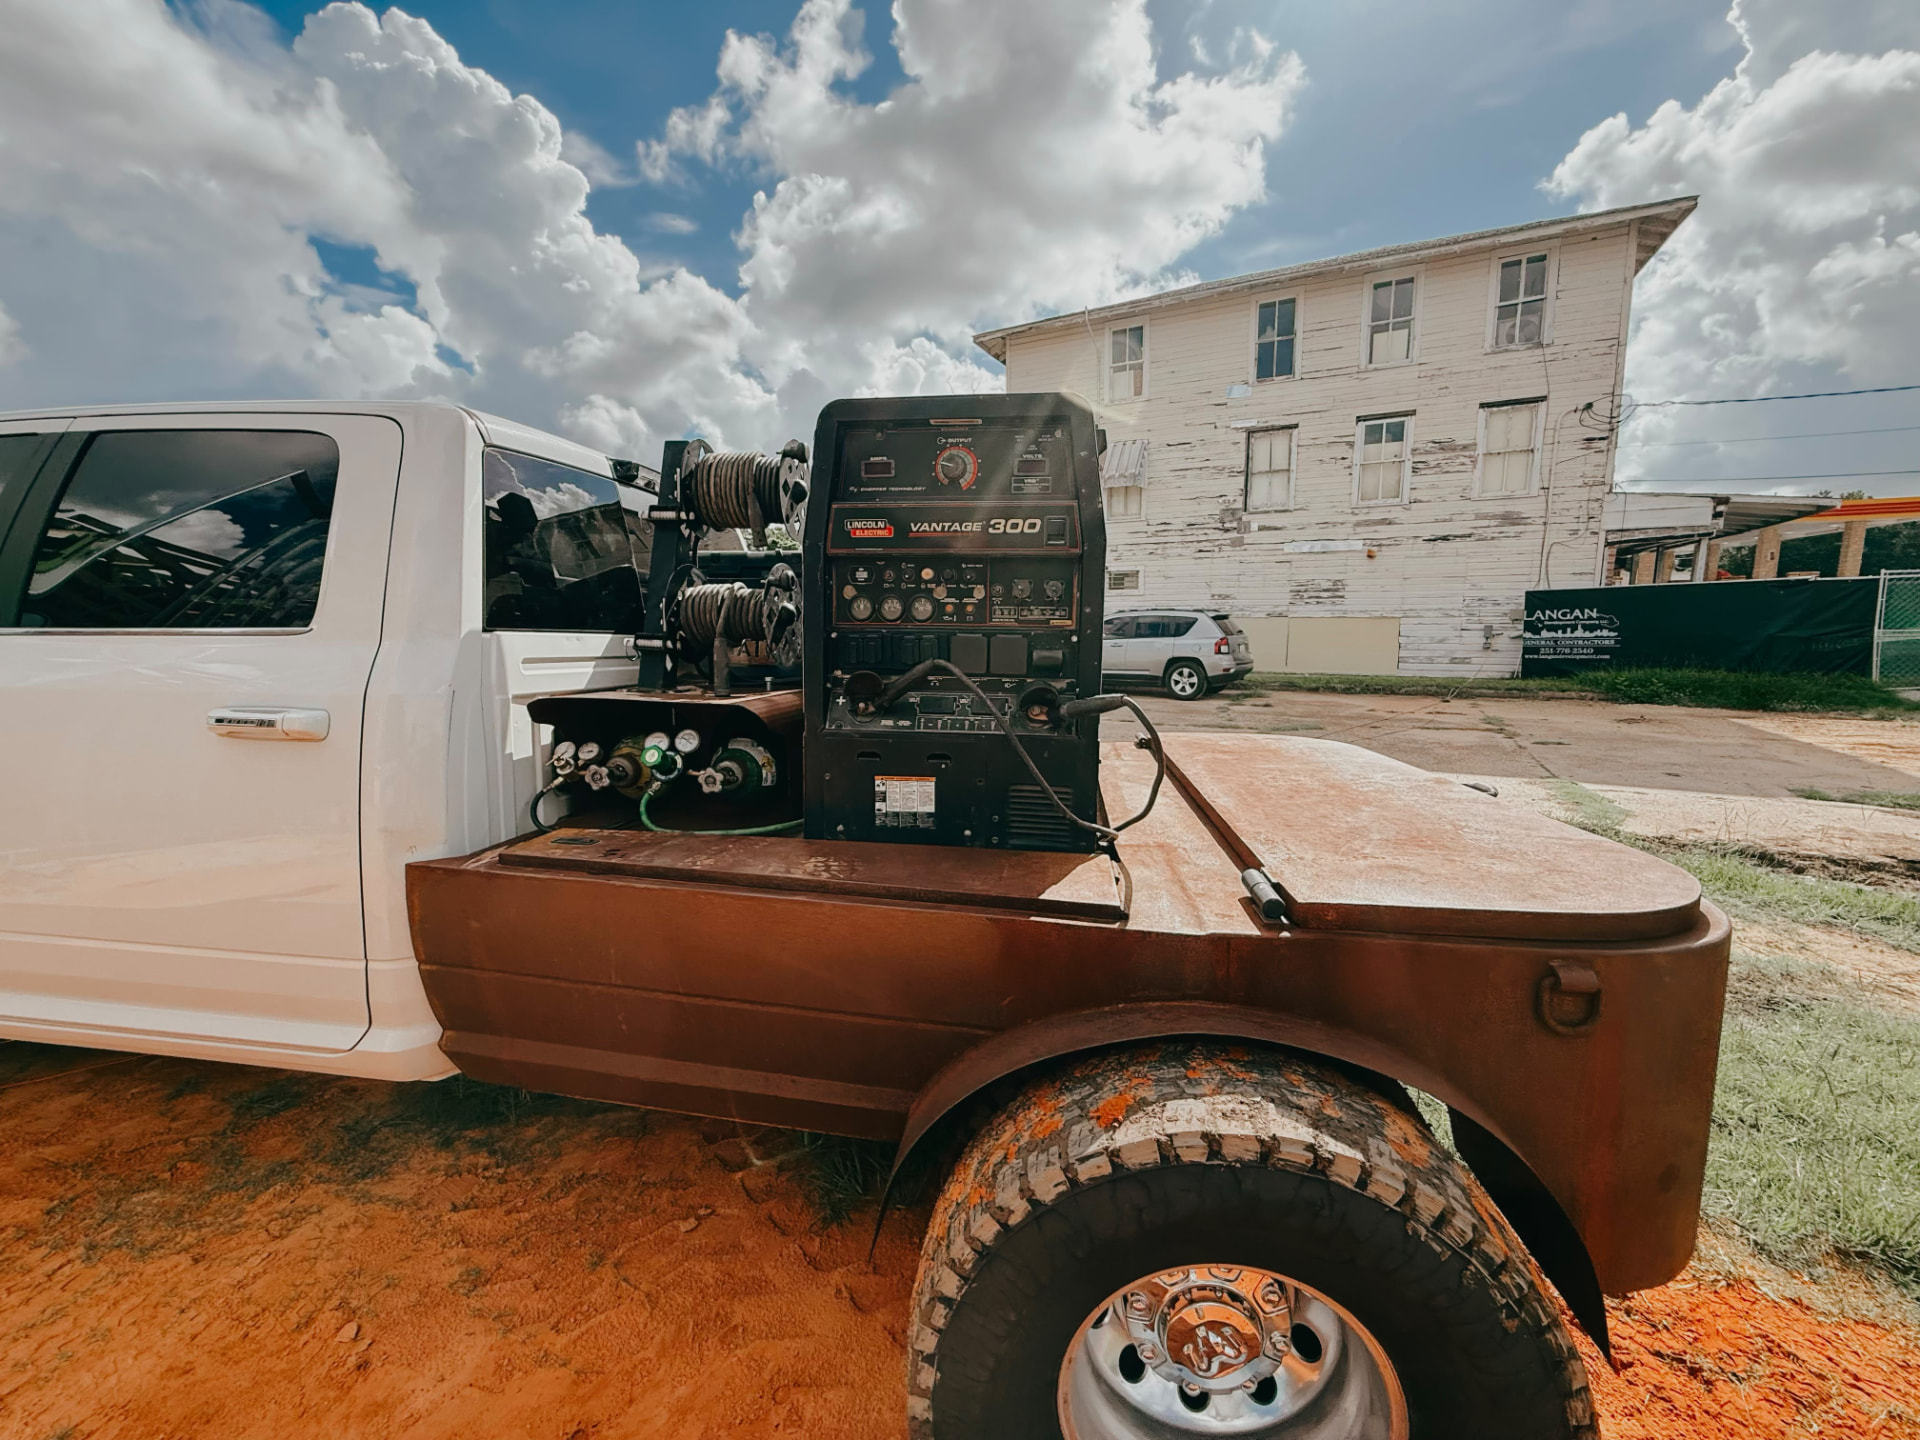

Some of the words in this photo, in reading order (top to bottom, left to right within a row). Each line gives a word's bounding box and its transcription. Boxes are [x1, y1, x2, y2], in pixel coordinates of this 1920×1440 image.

[847, 520, 886, 530] LINCOLN
[910, 522, 983, 532] VANTAGE
[988, 518, 1042, 534] 300
[855, 529, 890, 537] ELECTRIC
[1524, 608, 1597, 620] LANGAN
